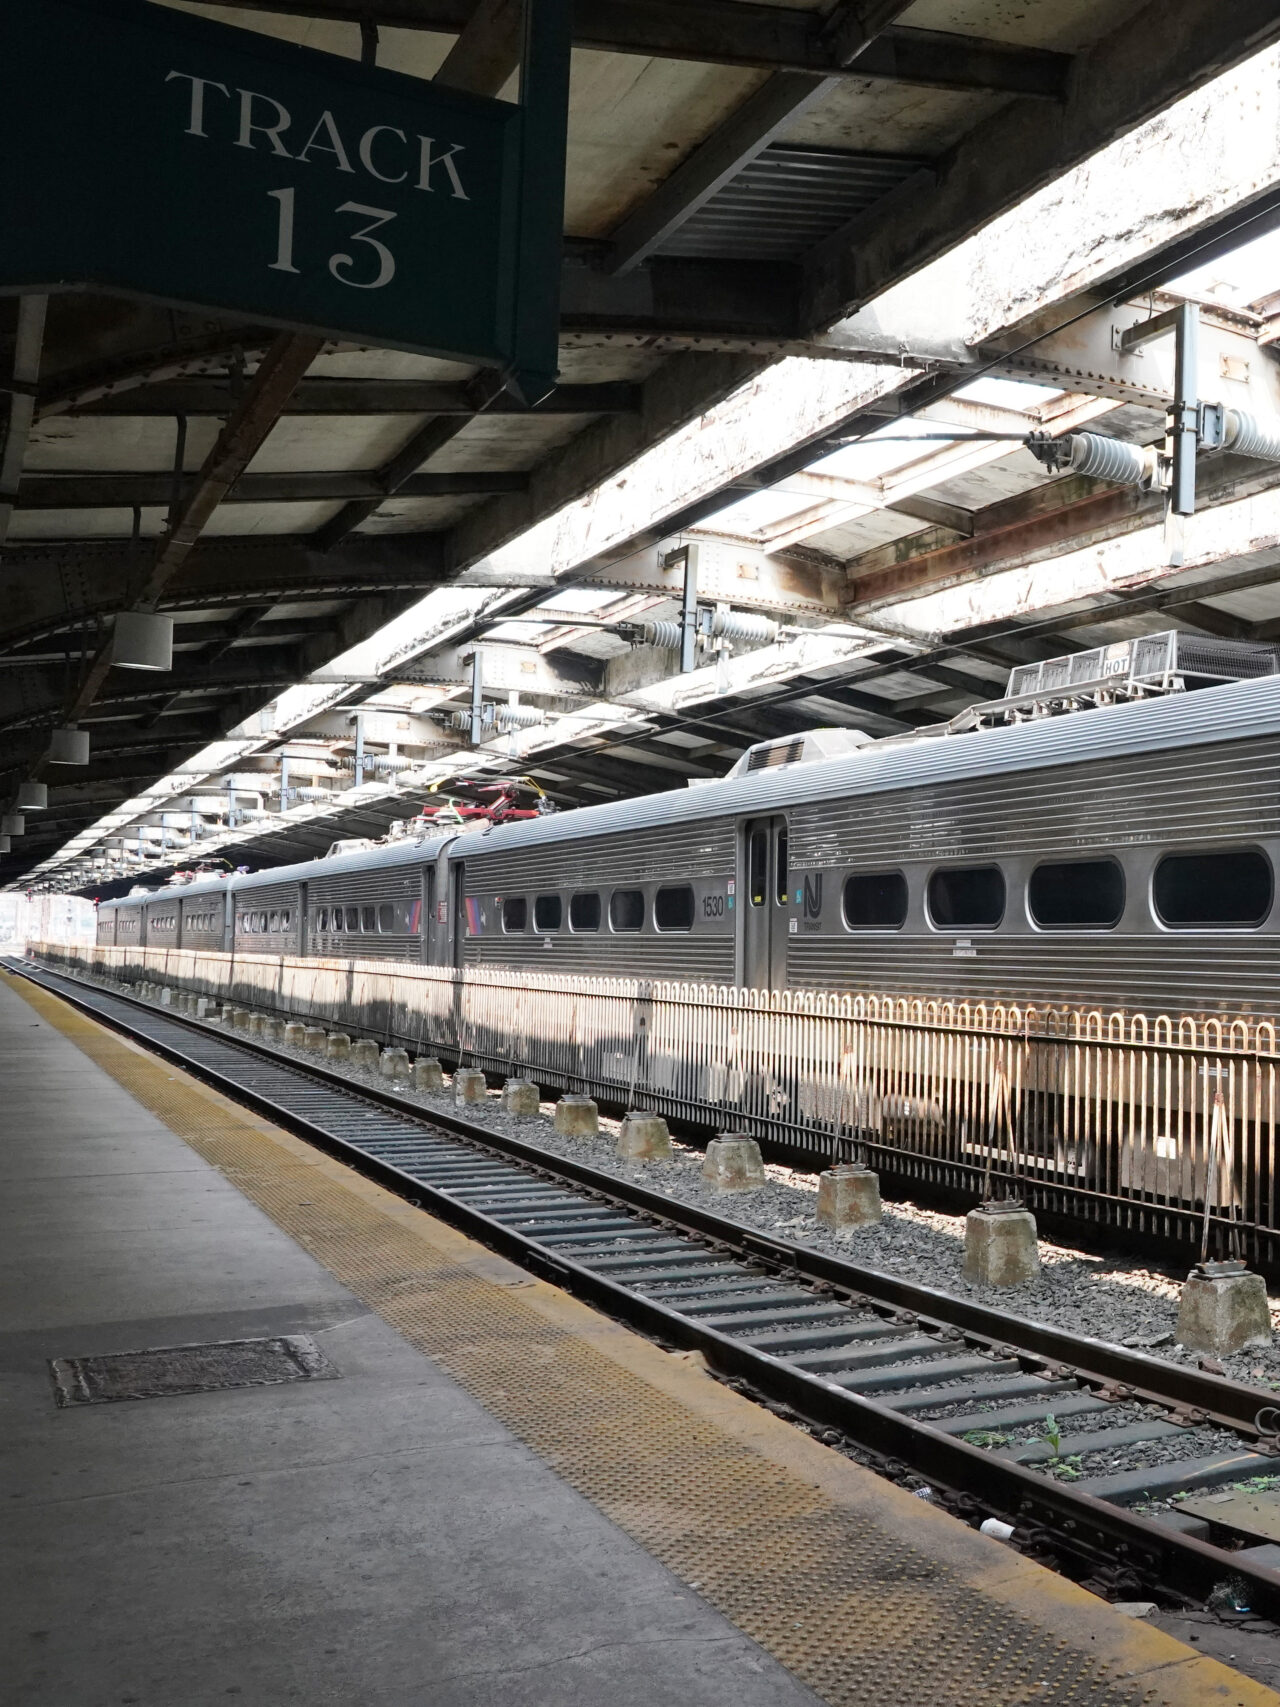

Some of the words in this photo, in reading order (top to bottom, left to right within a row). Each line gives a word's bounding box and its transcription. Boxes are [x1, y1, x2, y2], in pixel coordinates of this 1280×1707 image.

[164, 70, 471, 200] TRACK
[266, 187, 398, 289] 13
[1105, 658, 1128, 675] HOT
[702, 895, 724, 917] 1530
[803, 872, 823, 919] NJ
